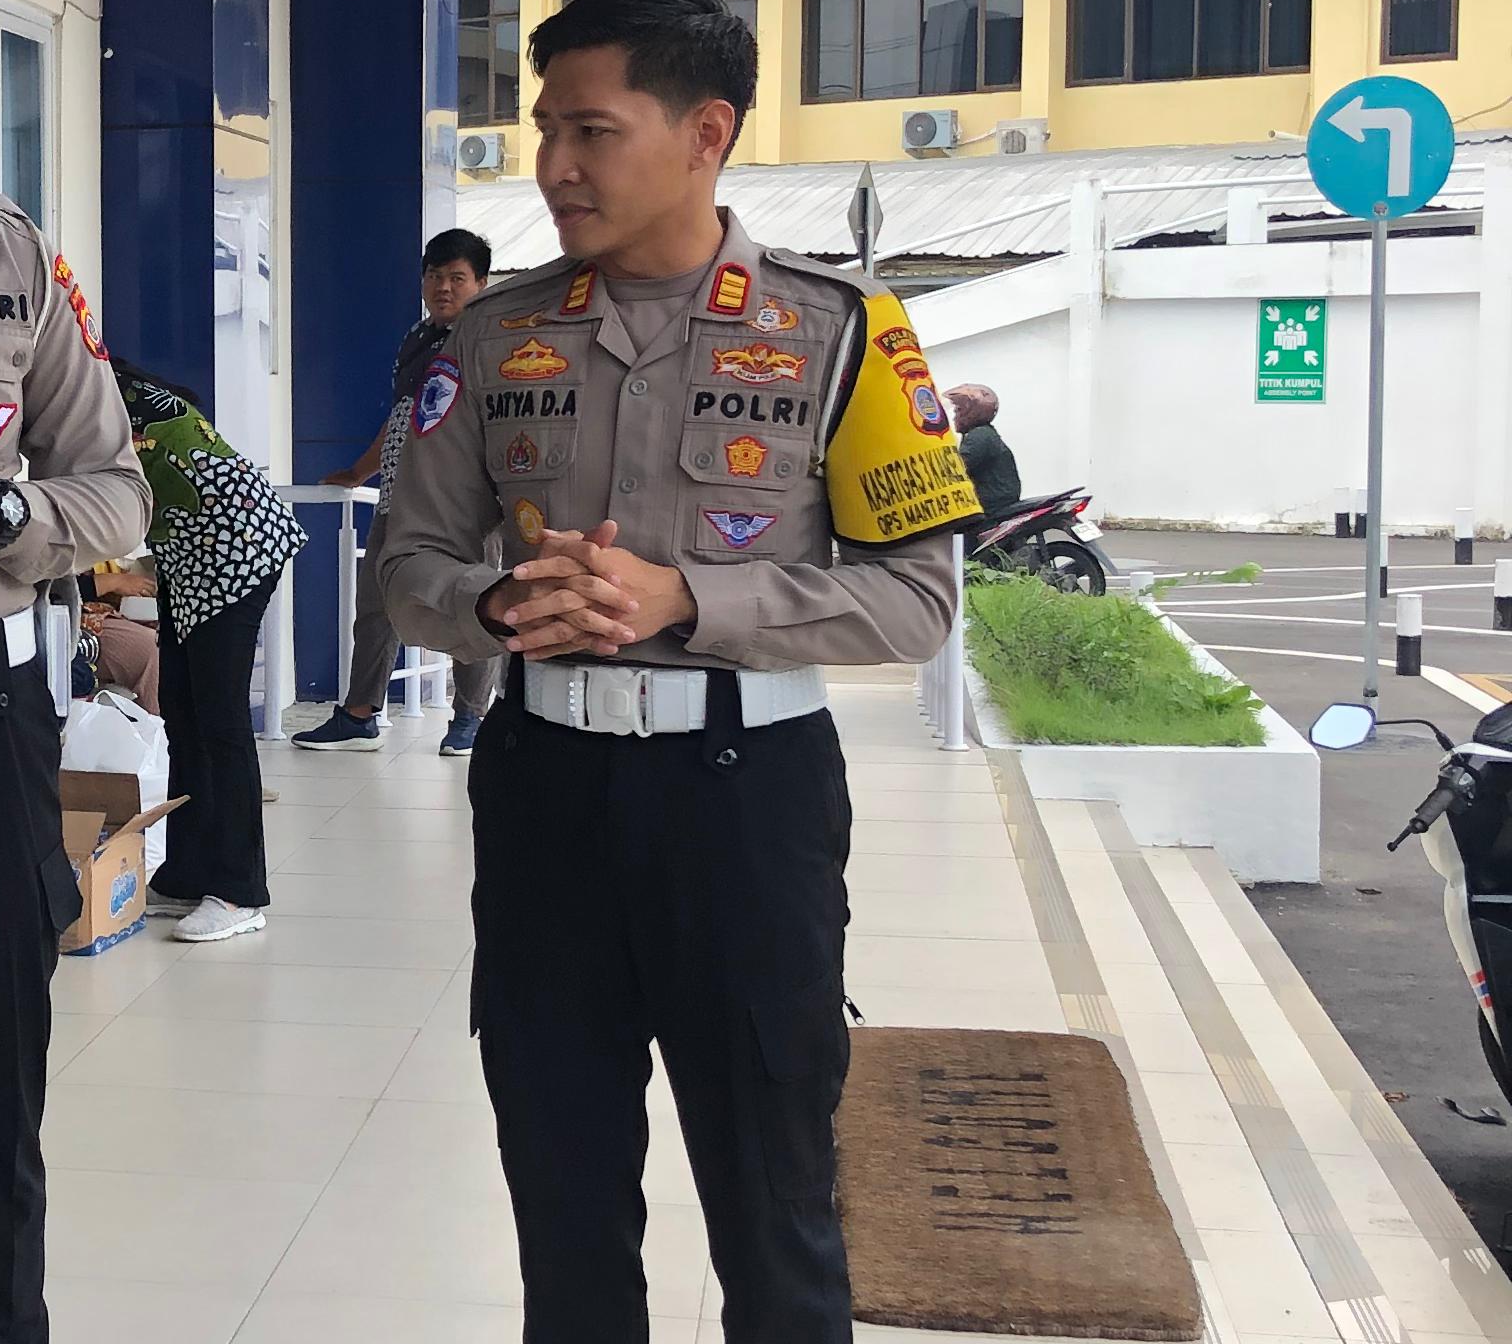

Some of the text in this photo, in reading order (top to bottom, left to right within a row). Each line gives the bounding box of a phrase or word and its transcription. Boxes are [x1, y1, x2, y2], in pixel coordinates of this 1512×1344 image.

[1259, 378, 1323, 388] TITIK KUMPUL
[485, 389, 576, 421] SATYA D.A
[693, 391, 809, 426] POLRI
[859, 455, 927, 513] KASATGAS
[877, 510, 903, 536] OPS
[902, 494, 950, 527] MANTAP
